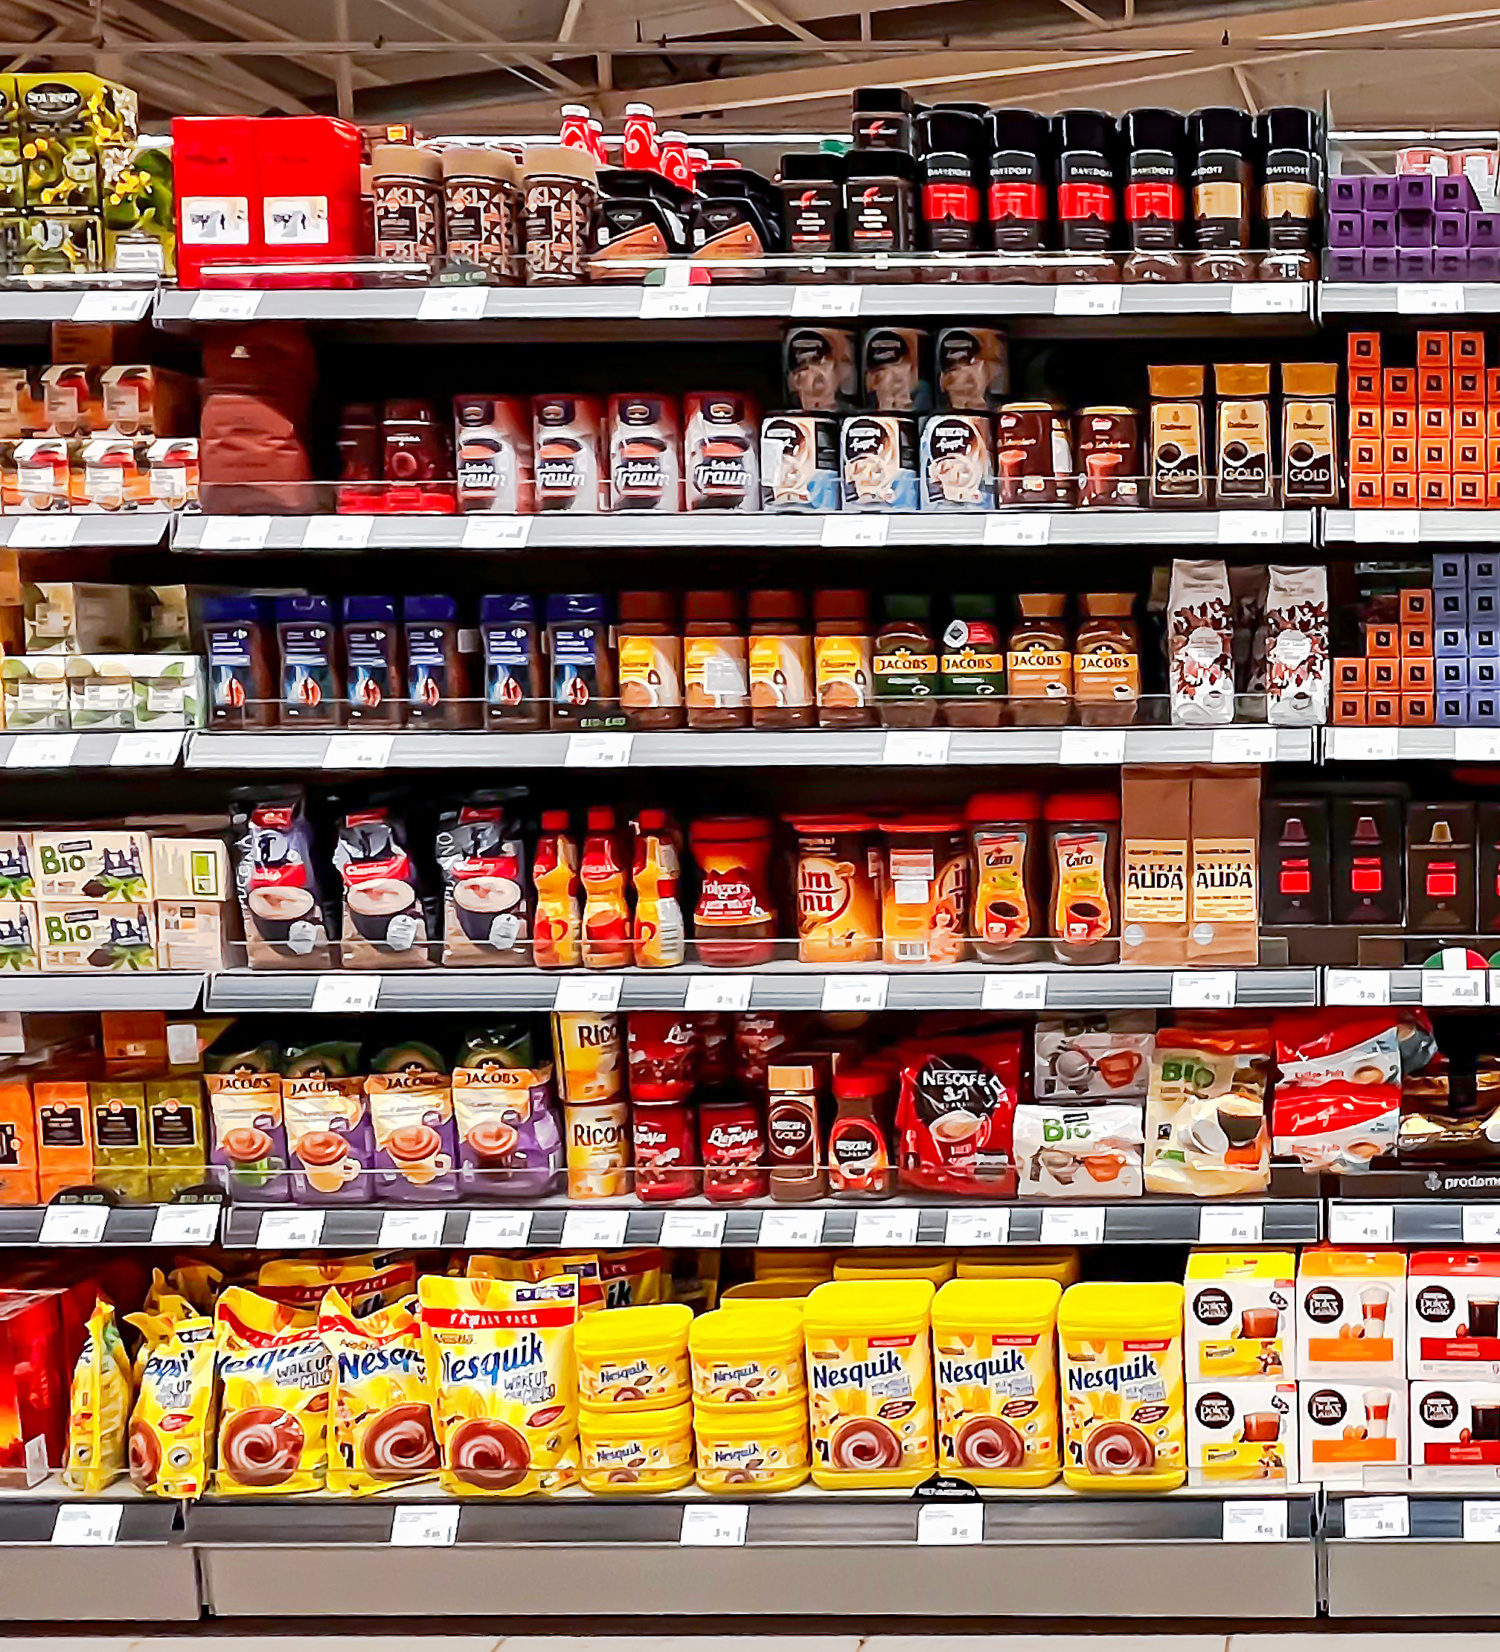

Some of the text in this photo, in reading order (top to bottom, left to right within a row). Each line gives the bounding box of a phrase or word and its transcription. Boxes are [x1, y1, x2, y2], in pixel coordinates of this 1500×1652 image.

[458, 468, 506, 486] Traum
[537, 468, 585, 486] Traum
[616, 466, 669, 486] Traum
[697, 465, 752, 486] Traum
[1156, 468, 1199, 482] GOLD
[1223, 466, 1265, 482] GOLD
[1289, 468, 1330, 482] GOLD
[879, 659, 929, 670] JACOBS
[945, 658, 993, 670] JACOBS
[1012, 654, 1063, 667] JACOBS
[1080, 657, 1130, 669] JACOBS
[40, 845, 86, 875] Bio
[702, 879, 752, 899] Folgers
[1128, 871, 1184, 891] AUDA
[1196, 871, 1253, 889] AUDA
[45, 916, 92, 945] Bio
[218, 1077, 271, 1090] JACOBS
[464, 1071, 520, 1085] JACOBS
[600, 1360, 650, 1383] Nesquik
[713, 1362, 760, 1383] Nesquik
[813, 1350, 902, 1389] Nesquik
[939, 1349, 1025, 1383] Nesquik
[1069, 1352, 1157, 1391] Nesquik
